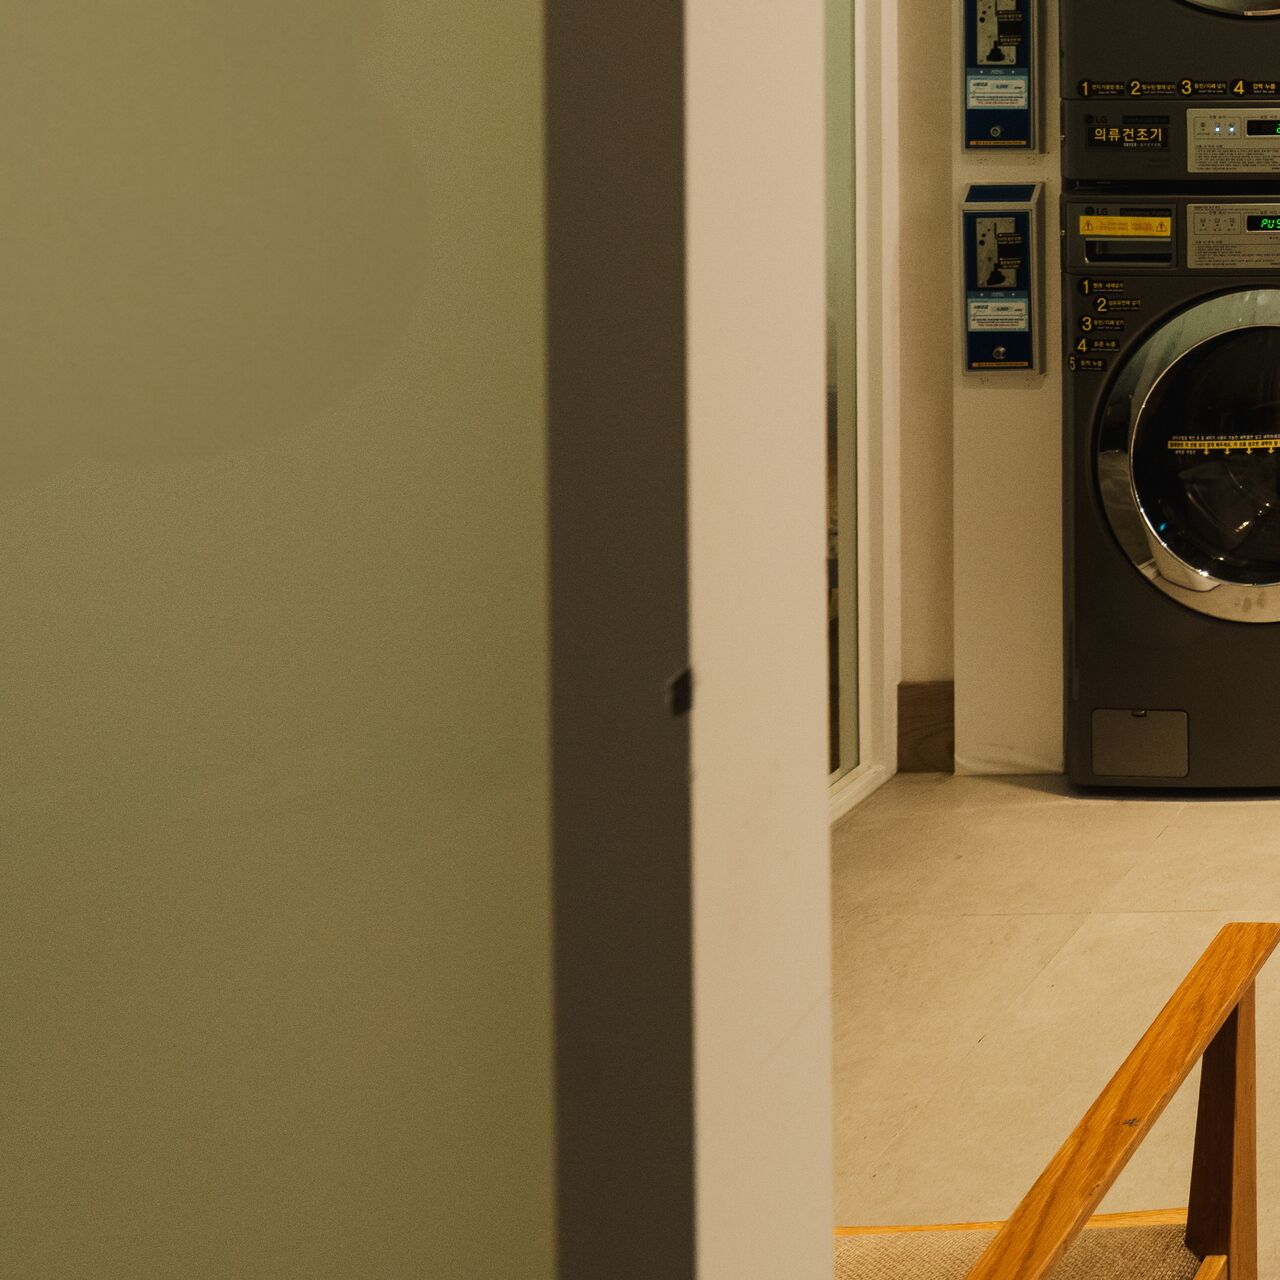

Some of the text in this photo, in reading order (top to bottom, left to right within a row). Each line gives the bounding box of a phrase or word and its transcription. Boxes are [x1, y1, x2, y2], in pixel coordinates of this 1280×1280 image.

[1083, 81, 1088, 96] 1
[1131, 81, 1141, 95] 2
[1181, 80, 1192, 94] 3
[1234, 80, 1244, 94] 4
[1094, 128, 1162, 142] 의류건조기
[1083, 280, 1088, 294] 1
[1097, 298, 1107, 312] 2
[1082, 317, 1092, 331] 3
[1077, 338, 1087, 352] 4
[1070, 356, 1076, 370] 5
